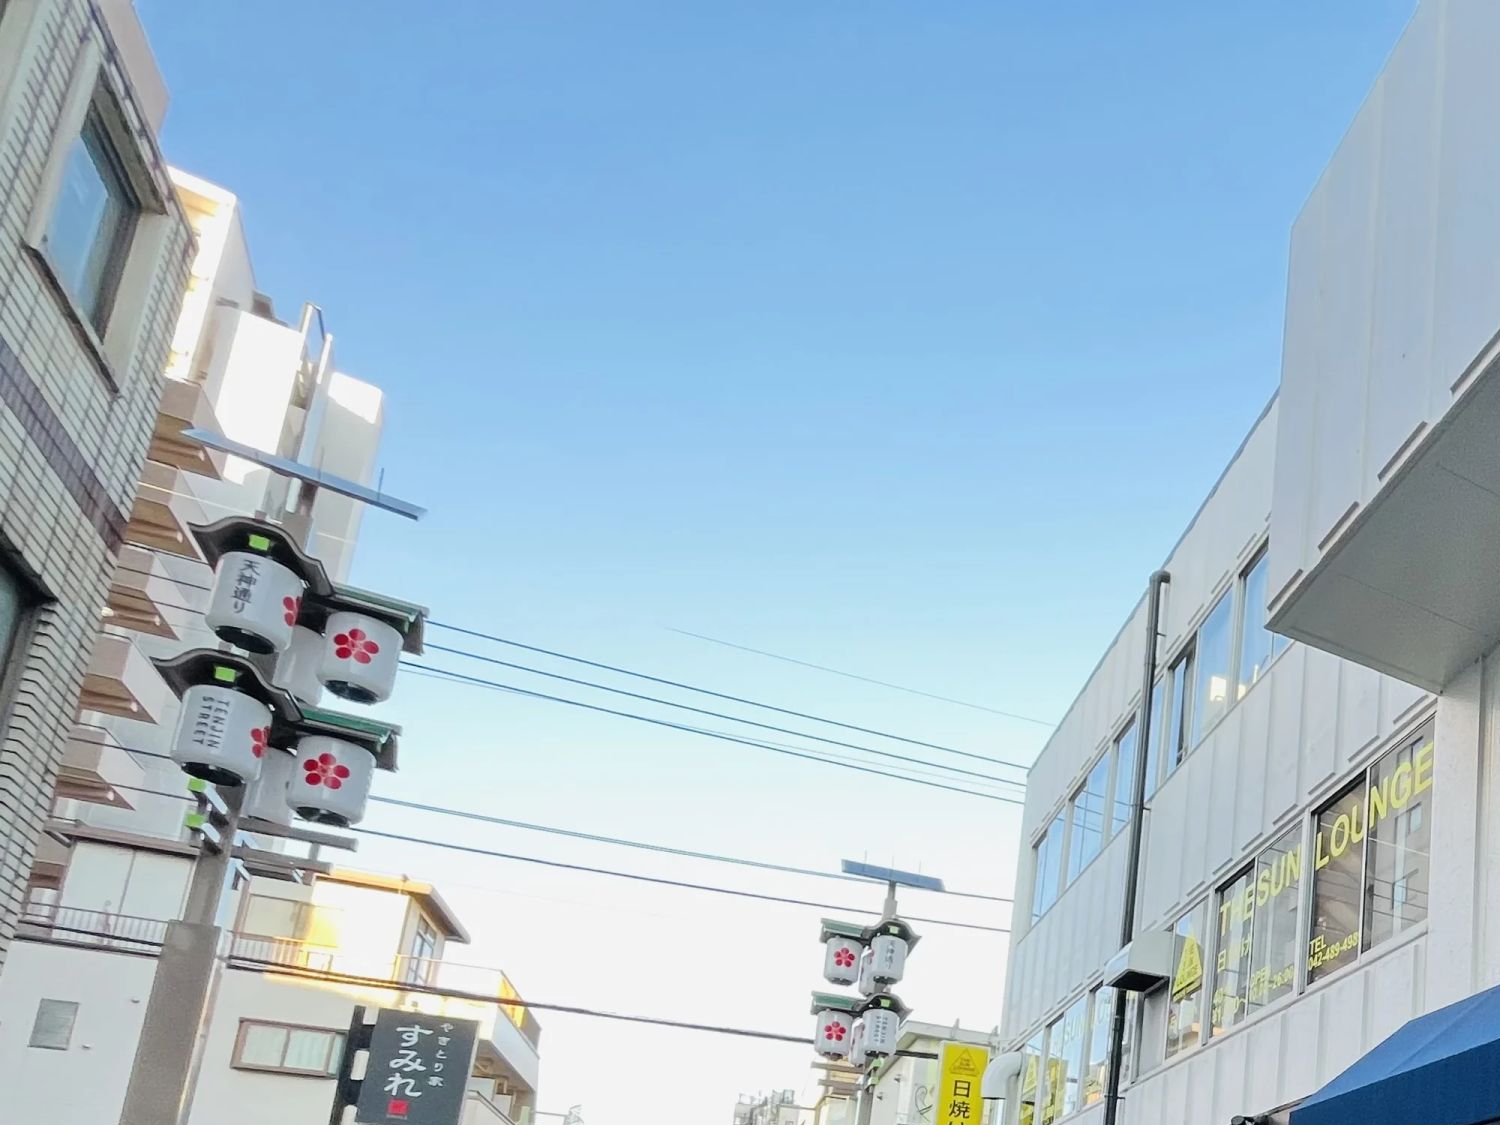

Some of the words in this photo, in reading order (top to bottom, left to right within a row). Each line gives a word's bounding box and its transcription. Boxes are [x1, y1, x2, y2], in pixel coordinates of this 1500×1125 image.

[232, 559, 261, 614] 天神通り
[192, 696, 210, 745] STREET
[207, 700, 230, 749] TENJIN
[384, 1025, 434, 1098] すみれ
